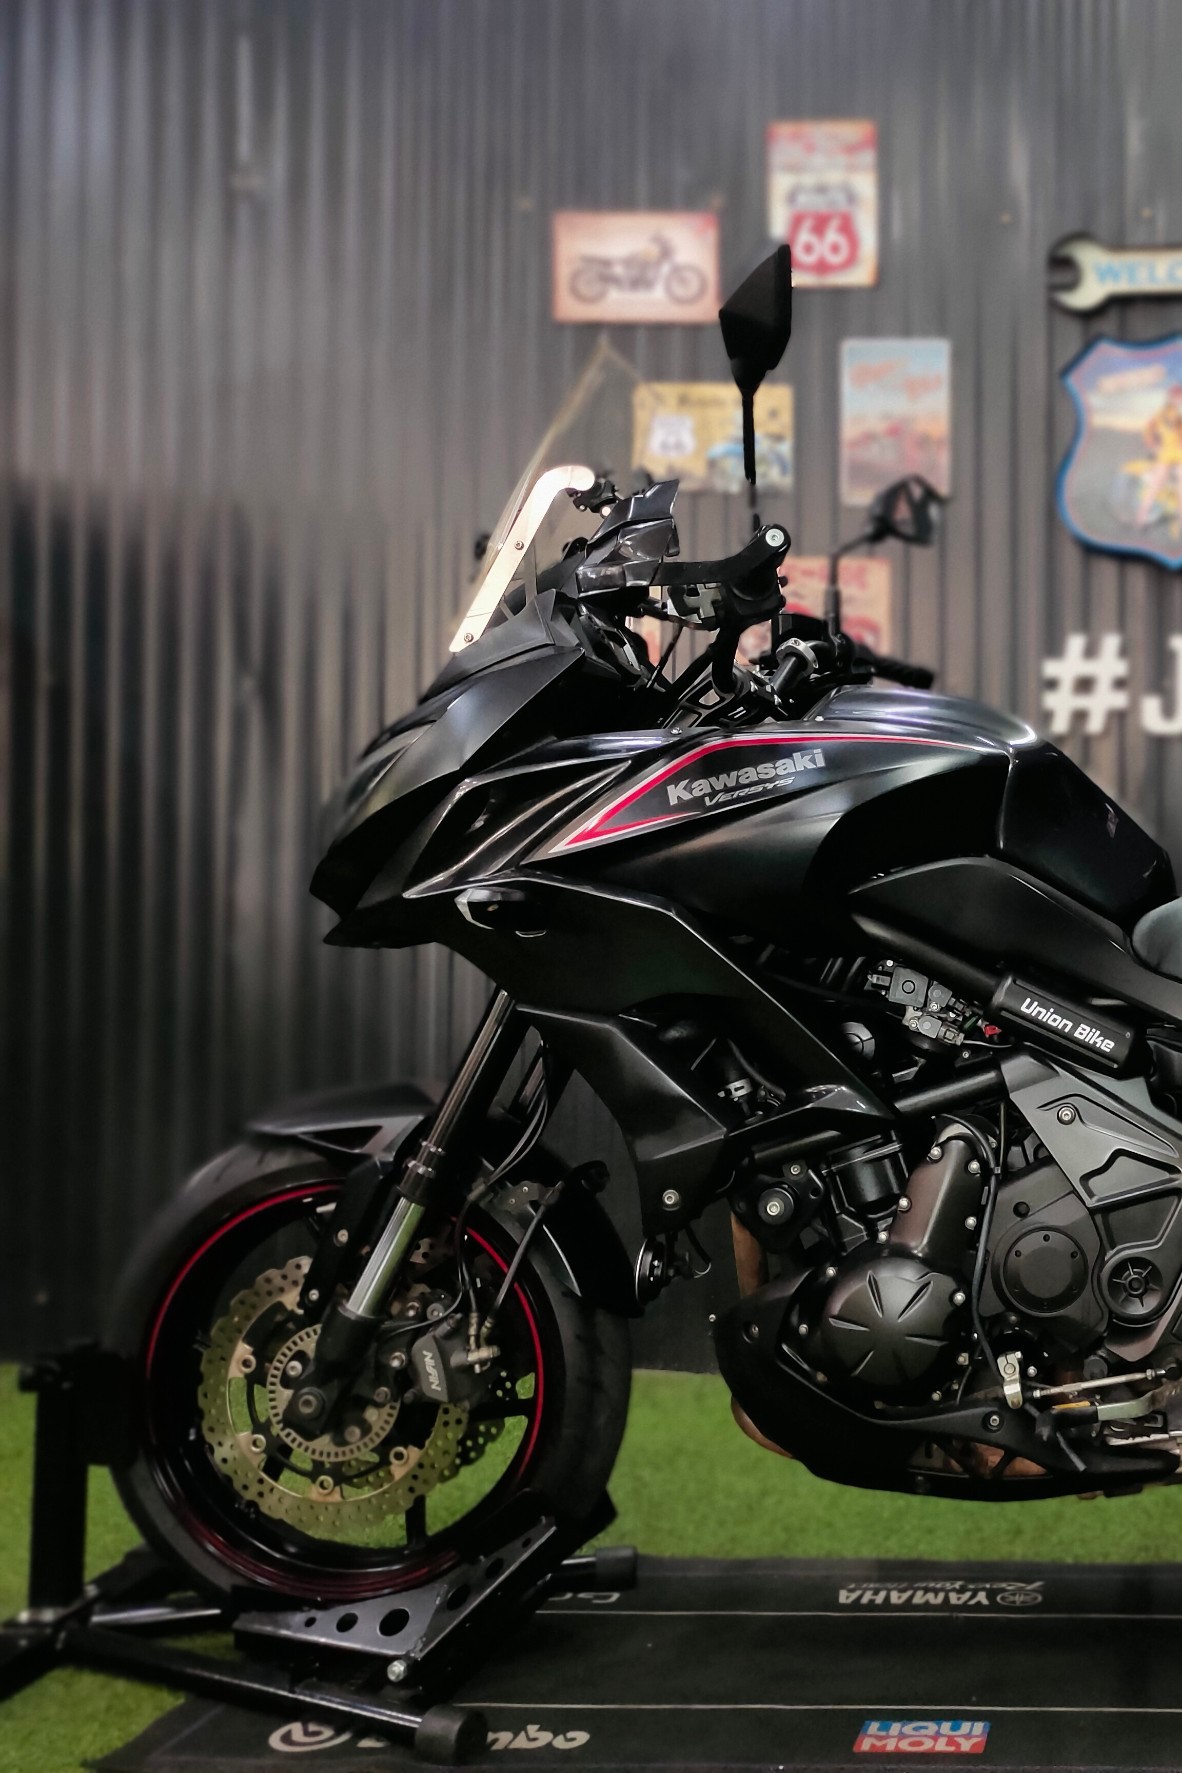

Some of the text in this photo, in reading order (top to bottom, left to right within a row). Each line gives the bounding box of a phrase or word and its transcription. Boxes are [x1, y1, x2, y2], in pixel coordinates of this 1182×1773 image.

[794, 215, 850, 265] 66
[666, 748, 827, 806] Kawasaki
[1020, 998, 1115, 1053] Union Bike
[838, 1589, 990, 1606] YAMAHA
[860, 1736, 983, 1752] MOLY
[866, 1721, 985, 1736] LIQUI
